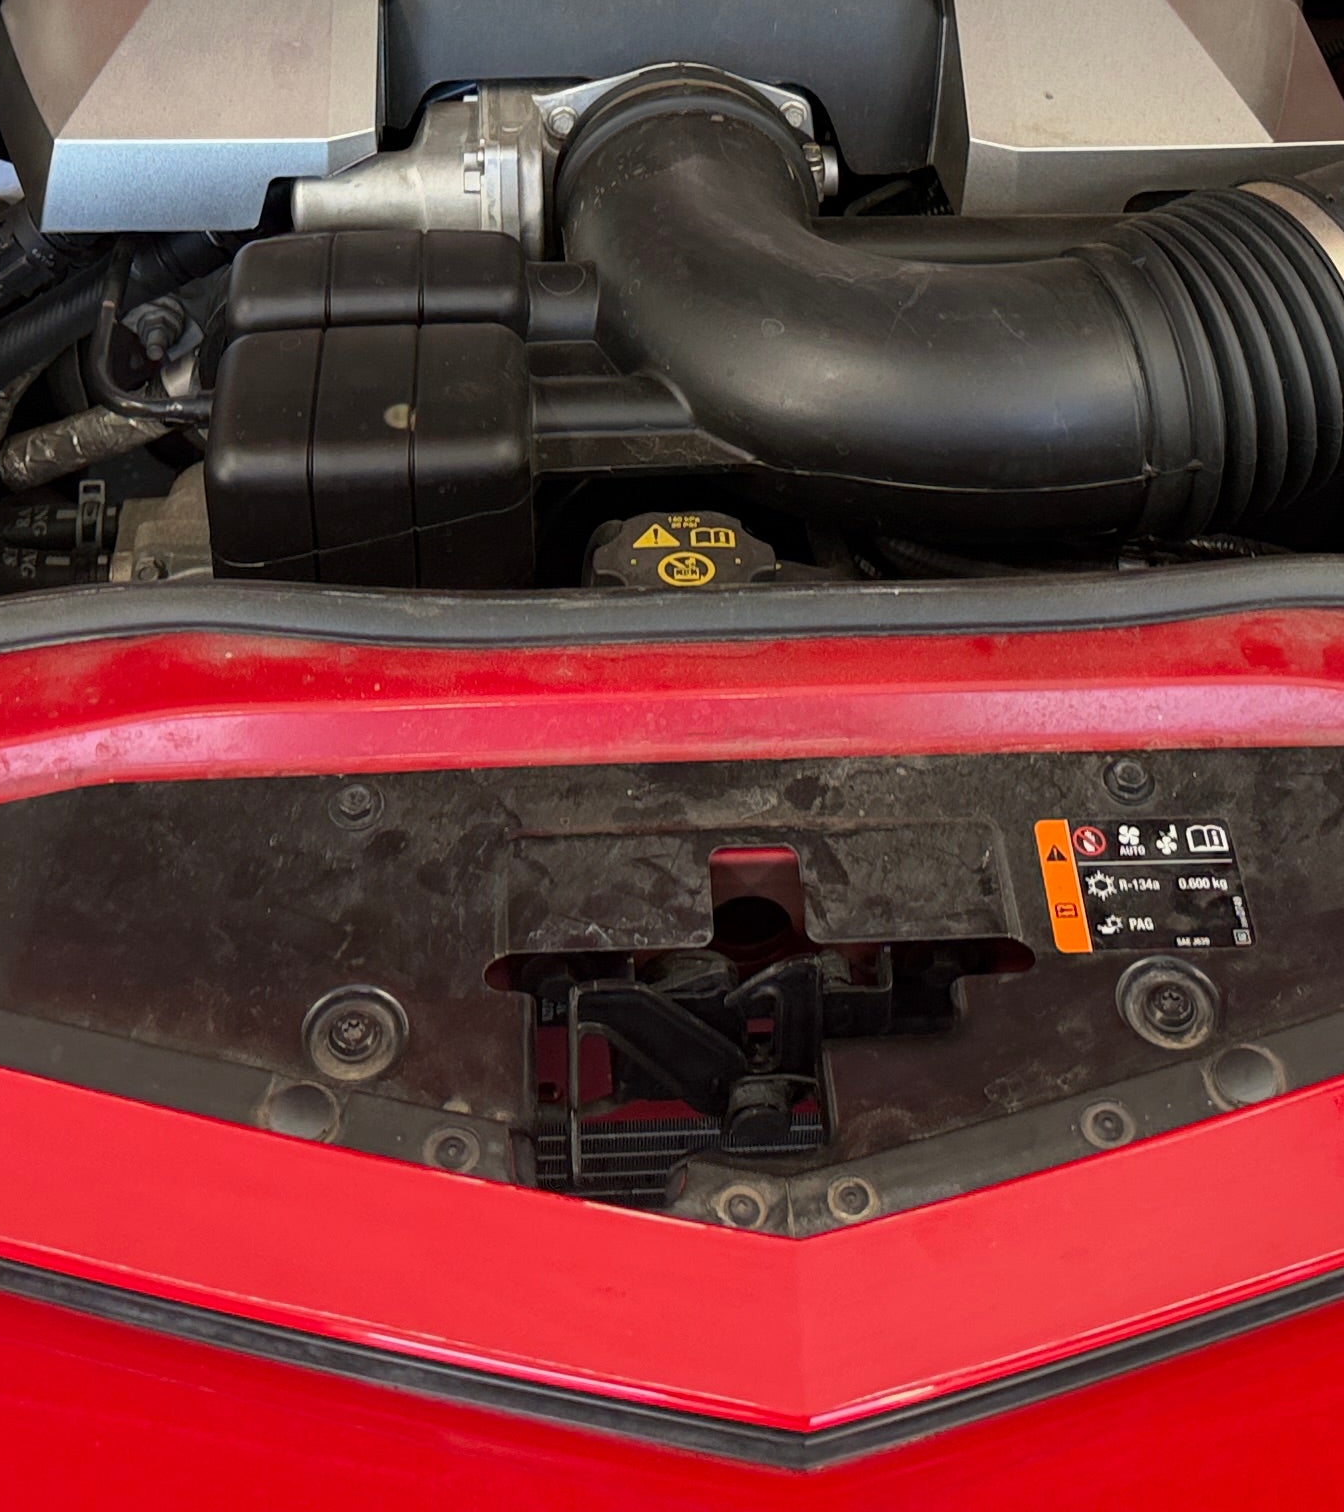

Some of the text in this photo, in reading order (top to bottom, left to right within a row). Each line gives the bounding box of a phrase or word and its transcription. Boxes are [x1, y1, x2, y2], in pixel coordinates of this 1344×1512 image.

[1119, 845, 1146, 856] AUTO
[1119, 878, 1161, 891] R-134a
[1212, 877, 1228, 891] kg
[1129, 917, 1155, 932] PAG
